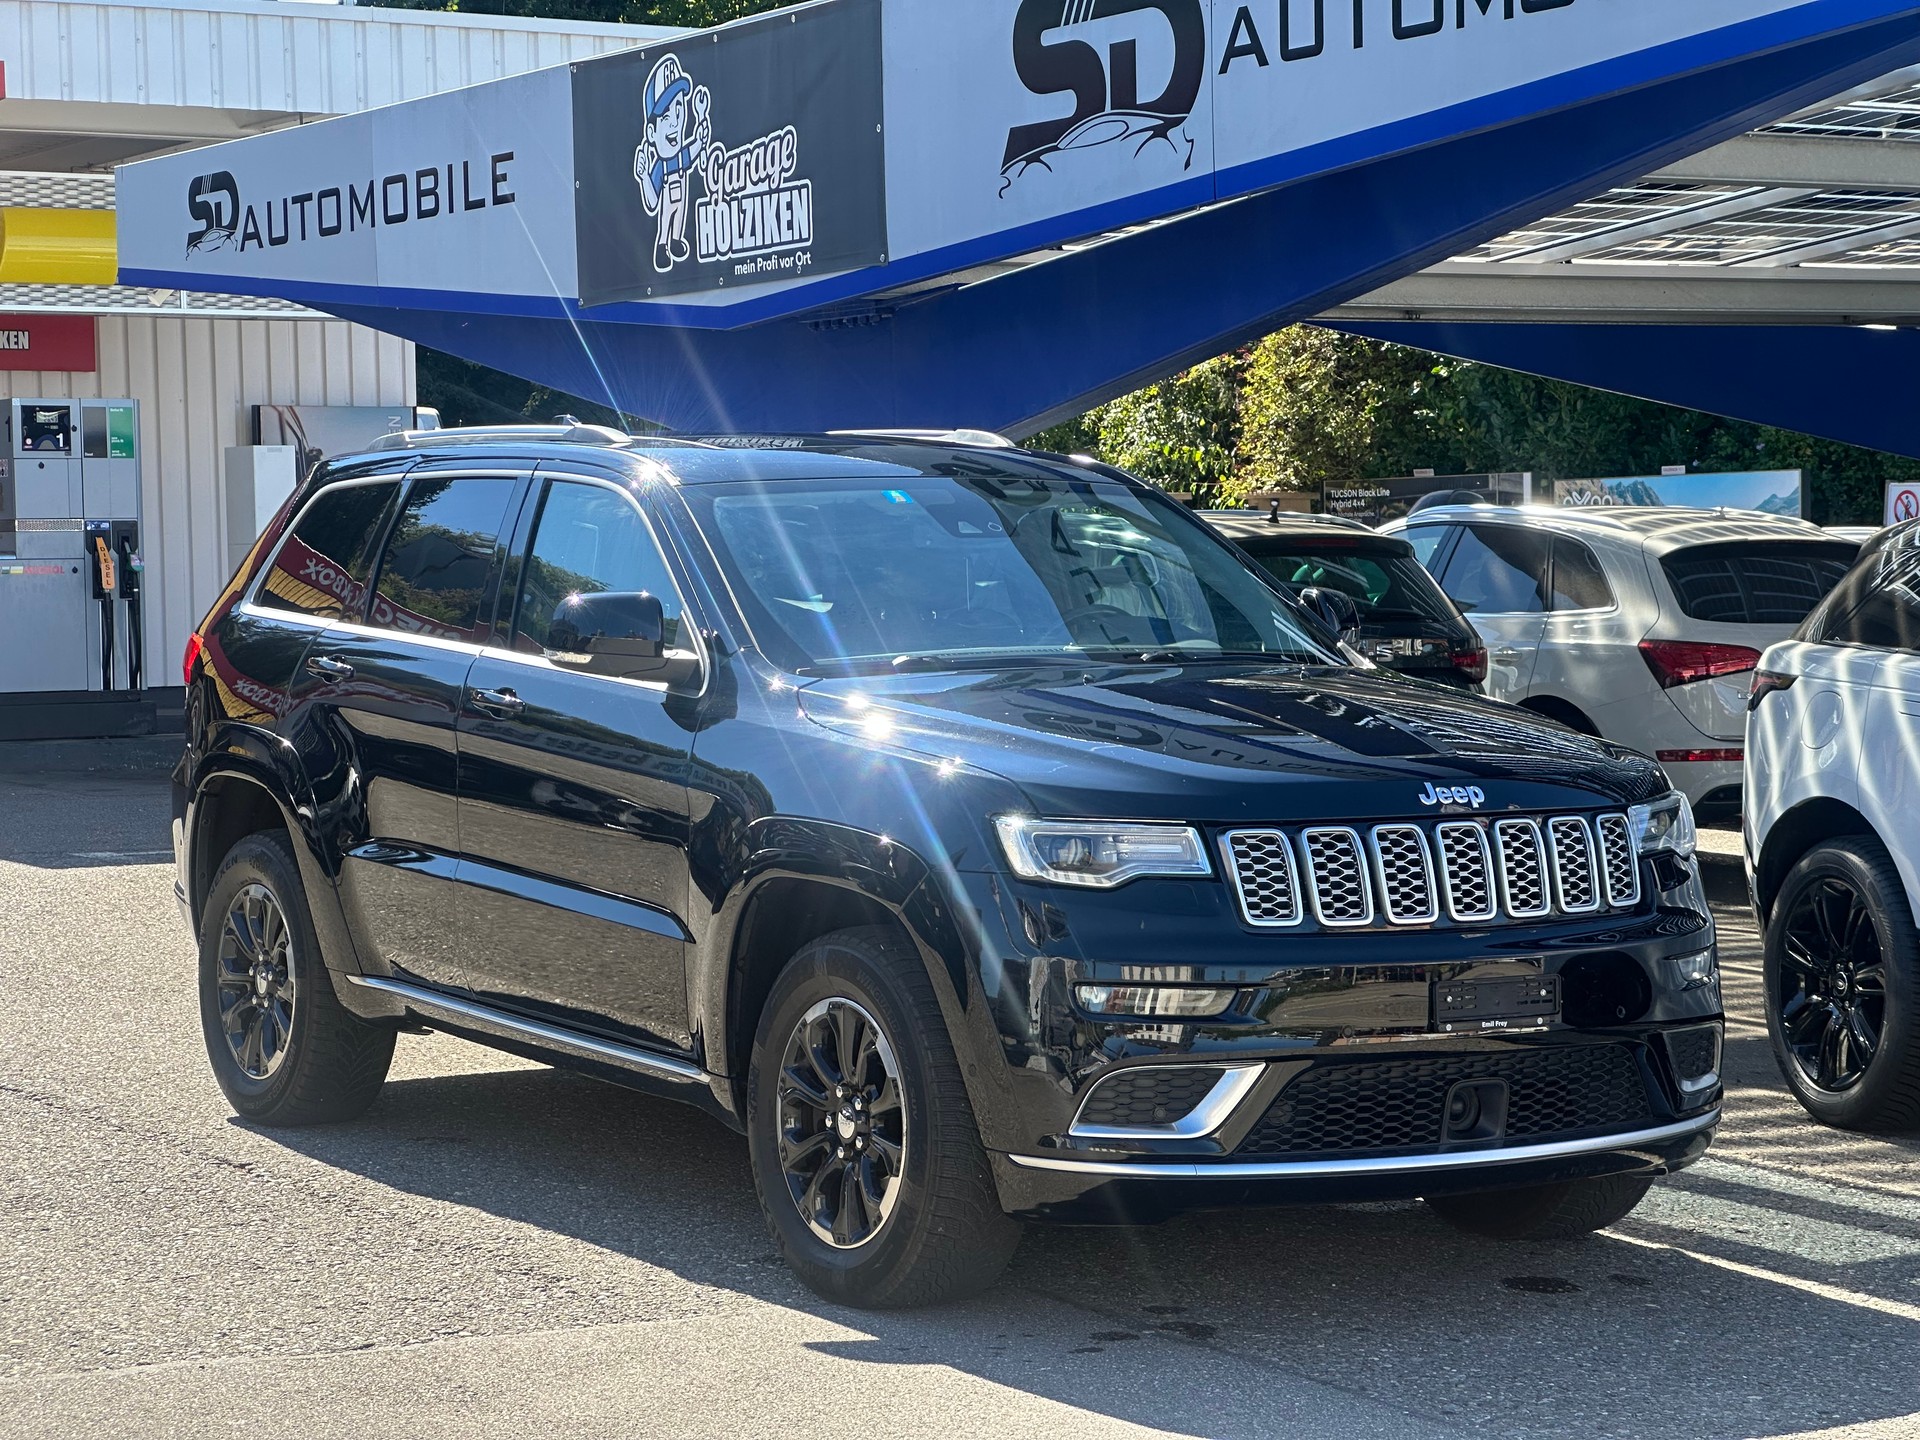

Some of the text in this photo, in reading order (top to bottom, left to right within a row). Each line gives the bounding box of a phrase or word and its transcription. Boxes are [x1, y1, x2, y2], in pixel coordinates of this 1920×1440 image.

[1218, 0, 1575, 74] AUTO
[707, 133, 793, 207] Garage
[240, 151, 517, 253] AUTOMOBILE
[699, 187, 809, 255] HOLZIKEN
[734, 251, 812, 275] mein Profi vor Ort
[1331, 489, 1357, 498] TUCSON
[1377, 487, 1390, 497] Line
[1331, 499, 1351, 508] Hybrid
[100, 546, 111, 586] DIESEL
[1418, 781, 1485, 809] Jeep
[1482, 1020, 1507, 1028] Emil Frey
